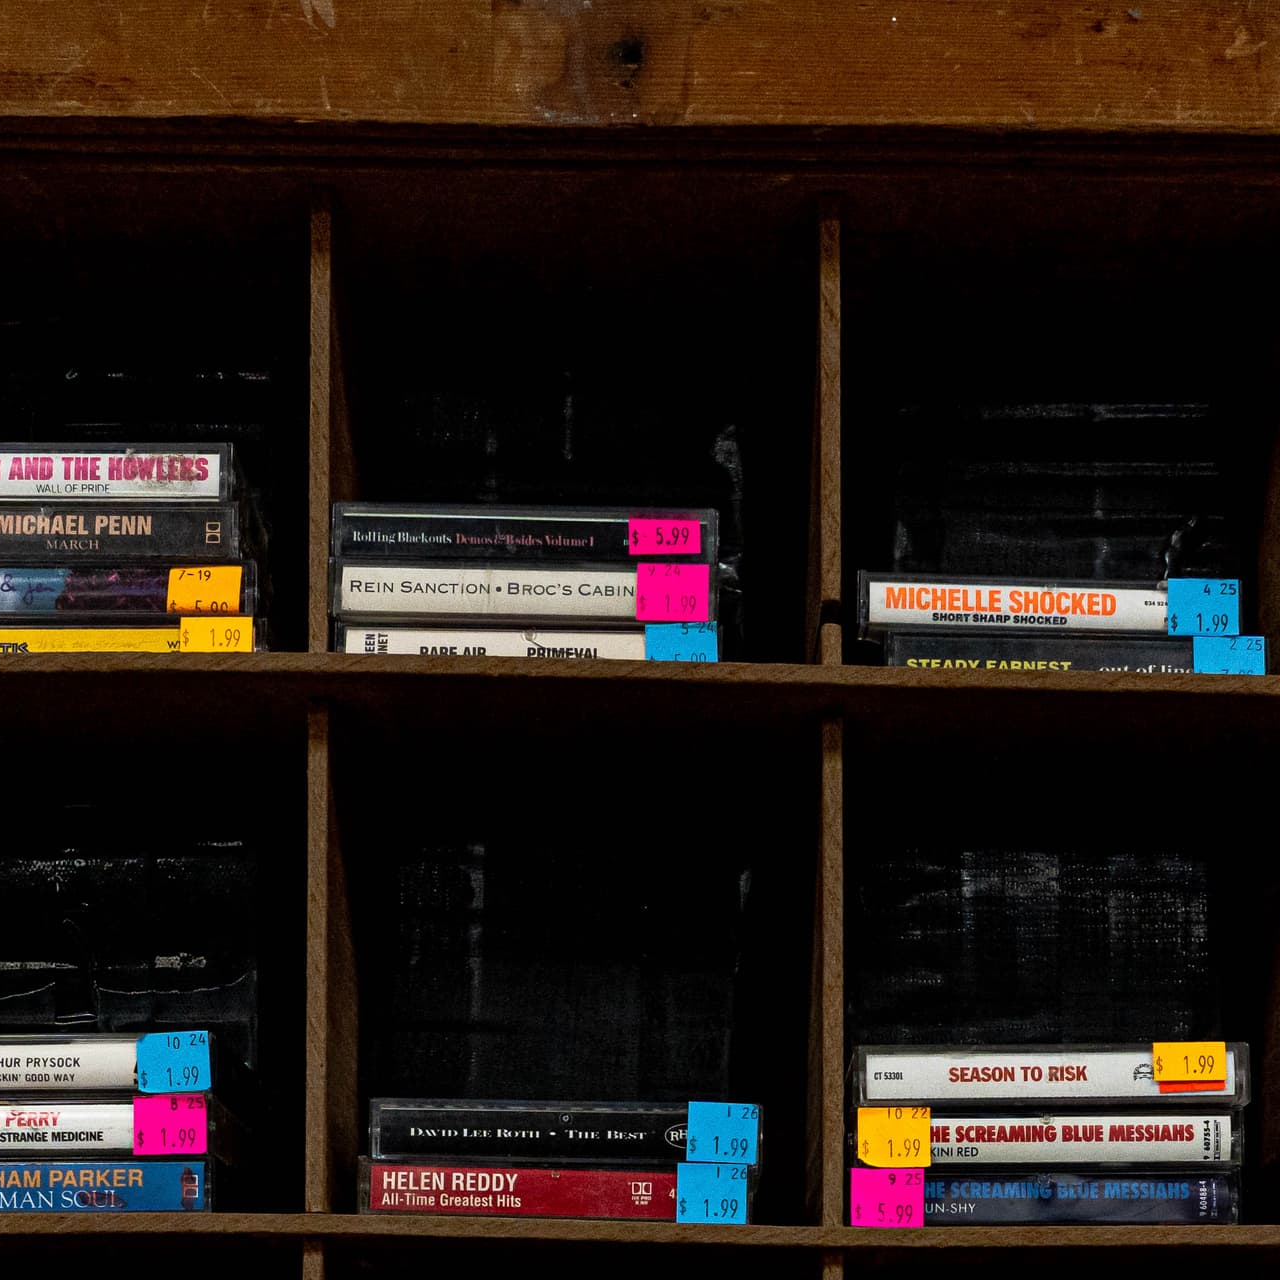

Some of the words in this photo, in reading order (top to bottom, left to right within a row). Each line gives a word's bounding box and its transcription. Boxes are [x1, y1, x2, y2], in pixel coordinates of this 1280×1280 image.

[8, 458, 53, 481] AND
[62, 458, 101, 481] THE
[108, 457, 209, 481] HOWLERS
[36, 484, 61, 493] WALL
[64, 484, 77, 494] OF
[81, 484, 110, 494] PRIDE
[95, 515, 152, 535] PENN
[46, 539, 99, 550] MARCH
[350, 580, 394, 593] REIN
[400, 581, 490, 595] SANCTION
[578, 584, 634, 596] CABIN
[886, 587, 1001, 612] MICHELLE
[1009, 591, 1116, 616] SHOCKED
[932, 612, 969, 622] SHORT
[973, 614, 1010, 624] SHARP
[1013, 615, 1067, 625] SHOCKED
[26, 1057, 80, 1068] PRYSOCK
[949, 1068, 1015, 1082] SEASON
[1021, 1068, 1043, 1082] TO
[1049, 1067, 1088, 1081] RISK
[0, 1132, 49, 1142] STRANGE
[52, 1131, 103, 1142] MEDICINE
[49, 1169, 143, 1188] PARKER
[383, 1172, 445, 1190] HELEN
[451, 1174, 517, 1193] REDDY
[382, 1193, 435, 1206] All-Time
[439, 1194, 492, 1207] Greatest
[497, 1195, 521, 1208] Hits
